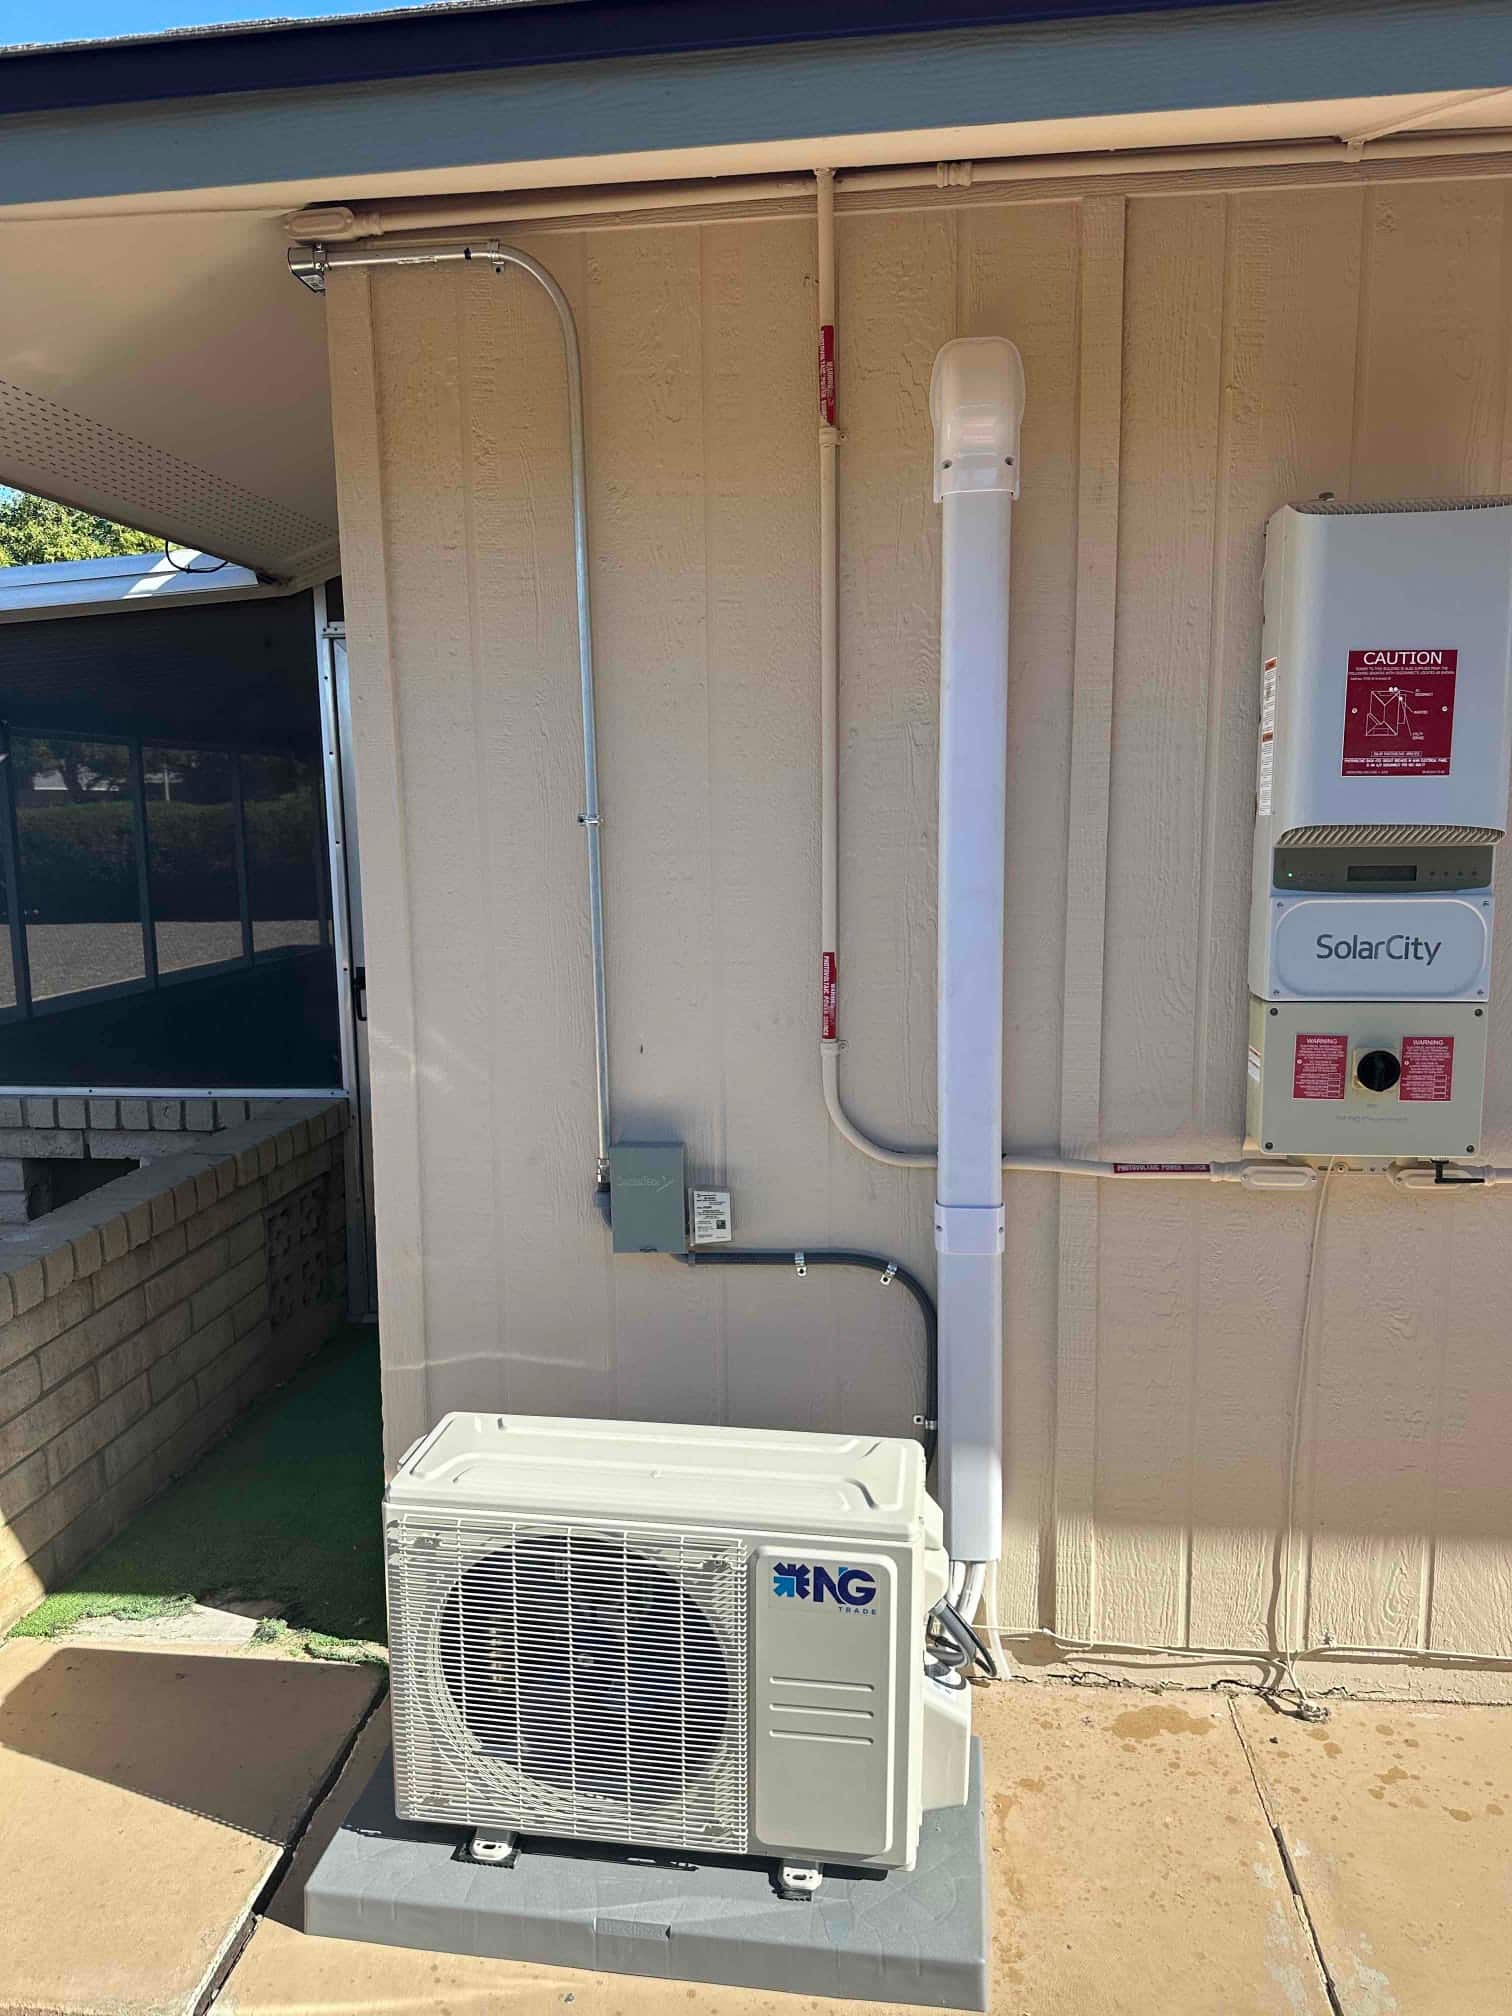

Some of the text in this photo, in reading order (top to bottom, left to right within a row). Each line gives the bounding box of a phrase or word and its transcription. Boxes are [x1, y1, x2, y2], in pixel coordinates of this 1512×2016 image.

[1363, 651, 1443, 665] CAUTION
[1316, 933, 1442, 966] SolarCity
[838, 1606, 877, 1615] TRADE
